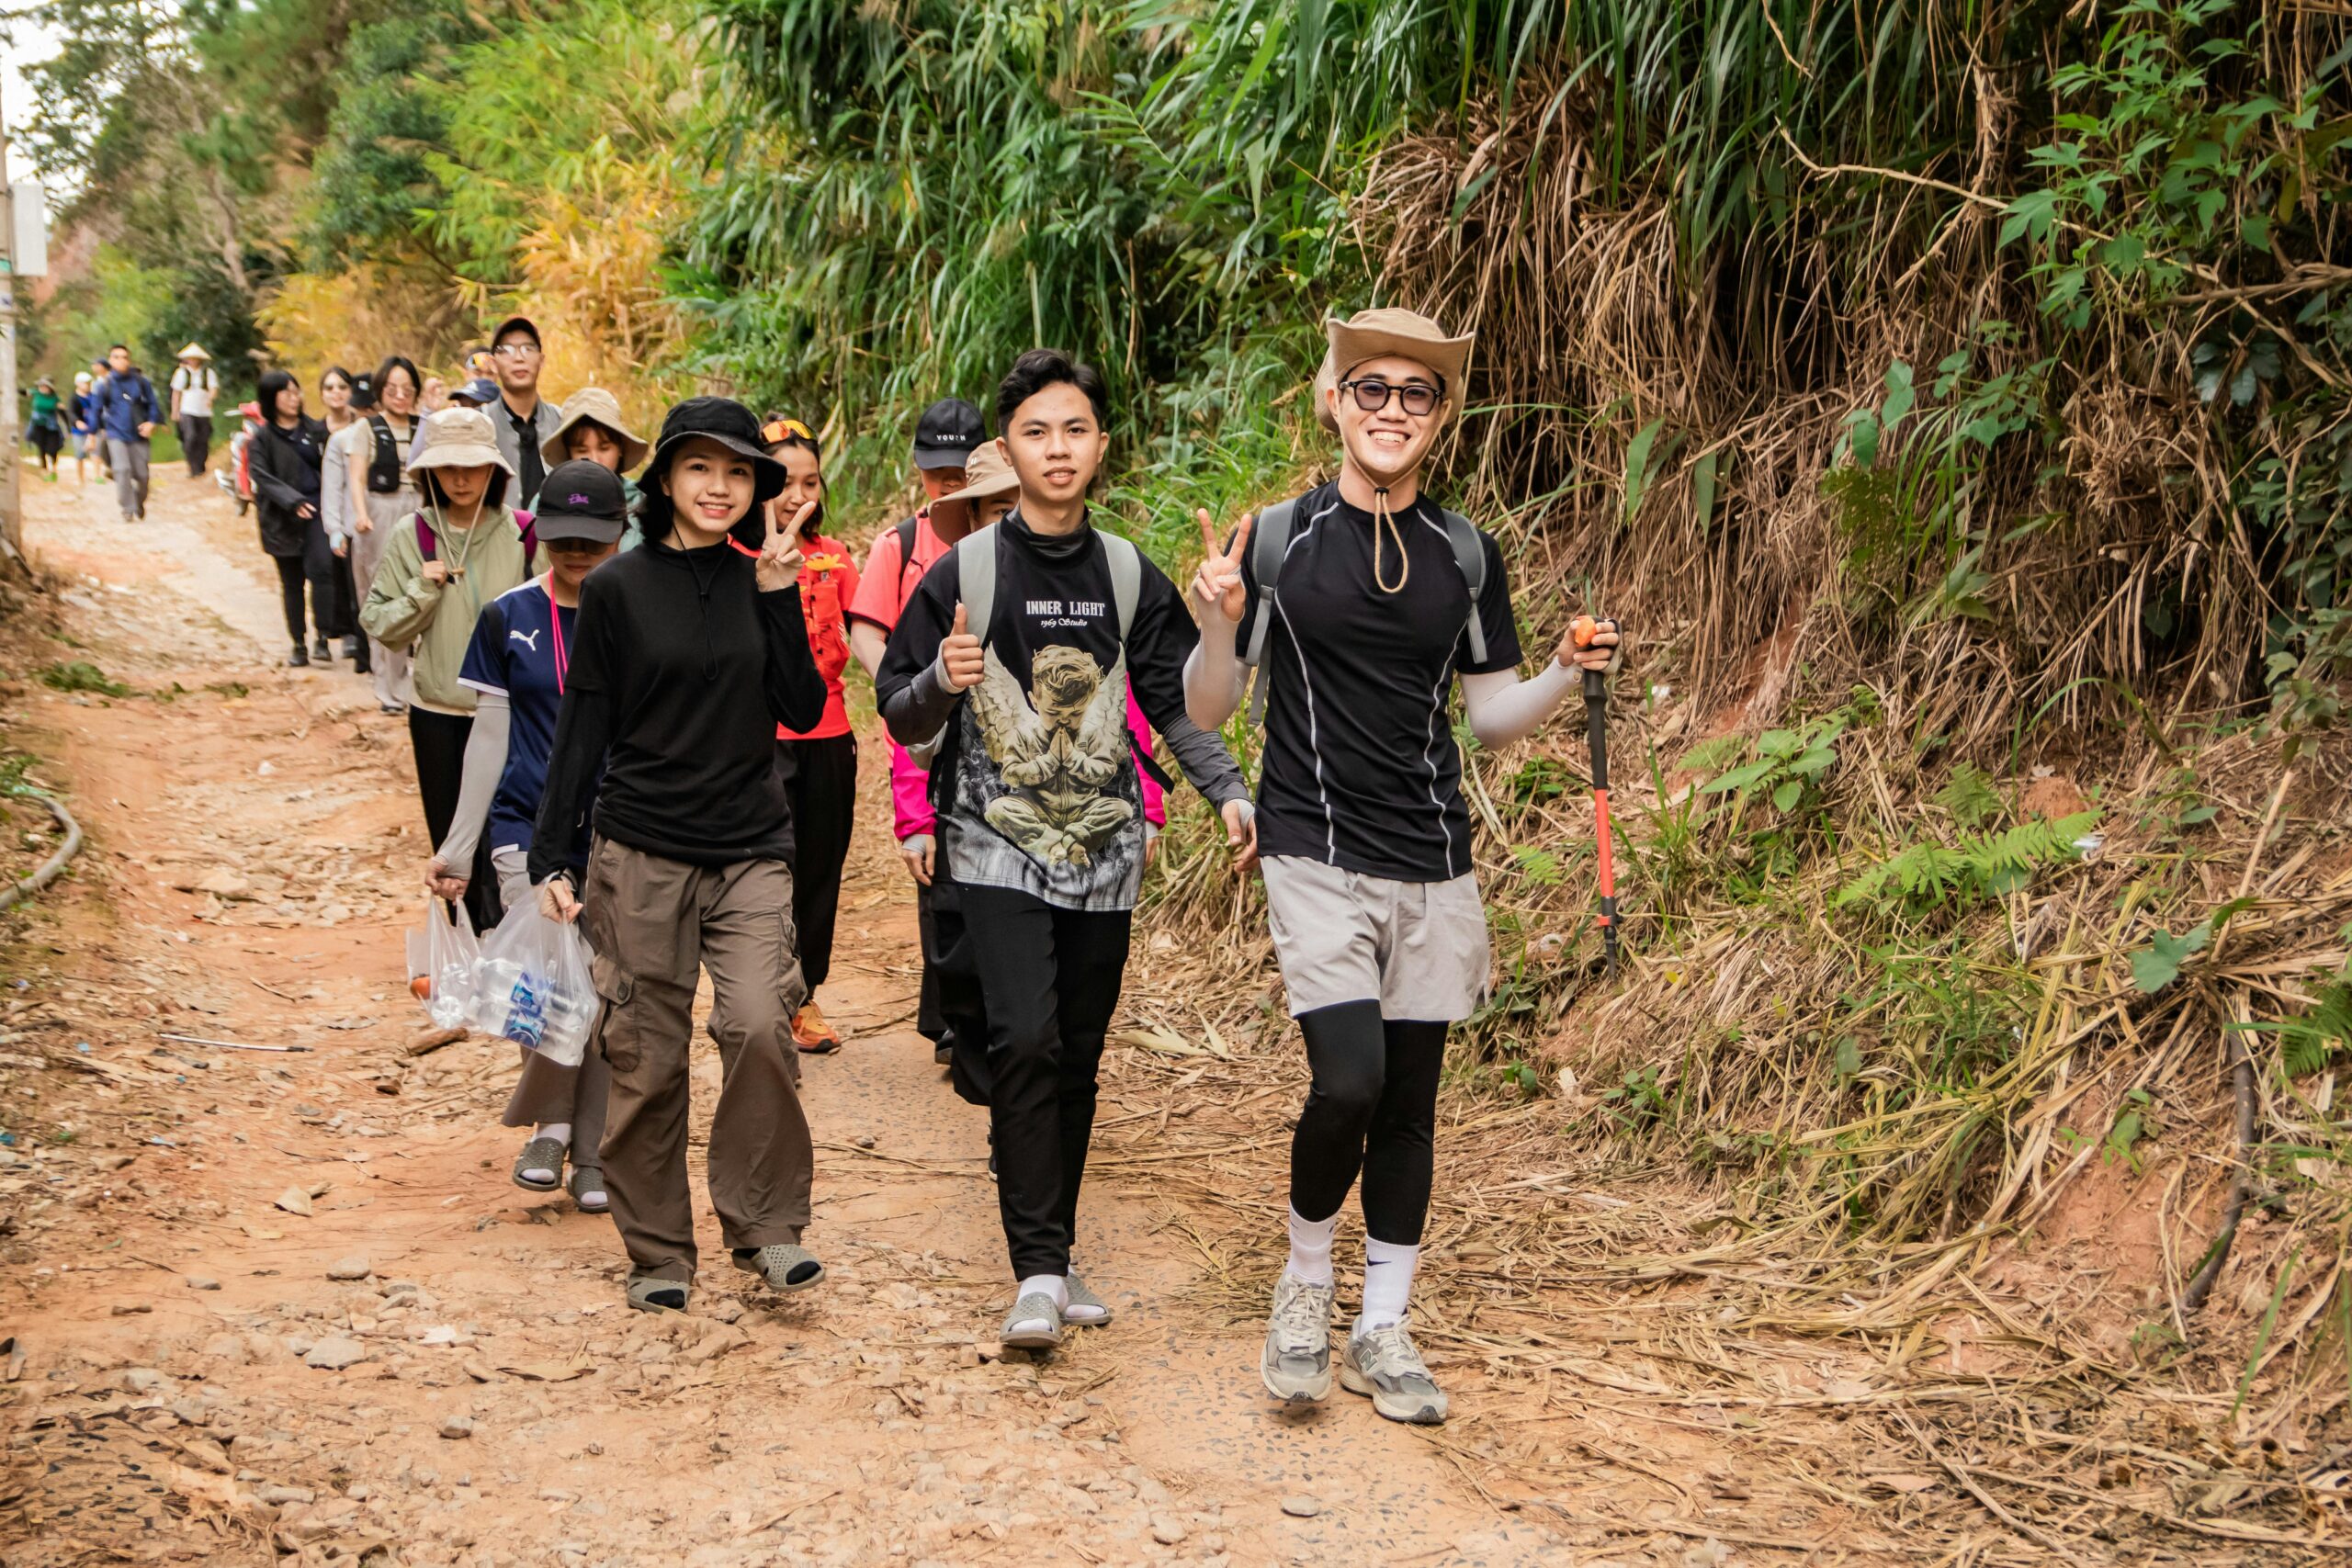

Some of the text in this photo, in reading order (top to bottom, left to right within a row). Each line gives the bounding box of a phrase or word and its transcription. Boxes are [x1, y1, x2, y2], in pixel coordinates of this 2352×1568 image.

[1025, 601, 1105, 617] INNER LIGHT
[1040, 617, 1088, 628] 1969 Studio
